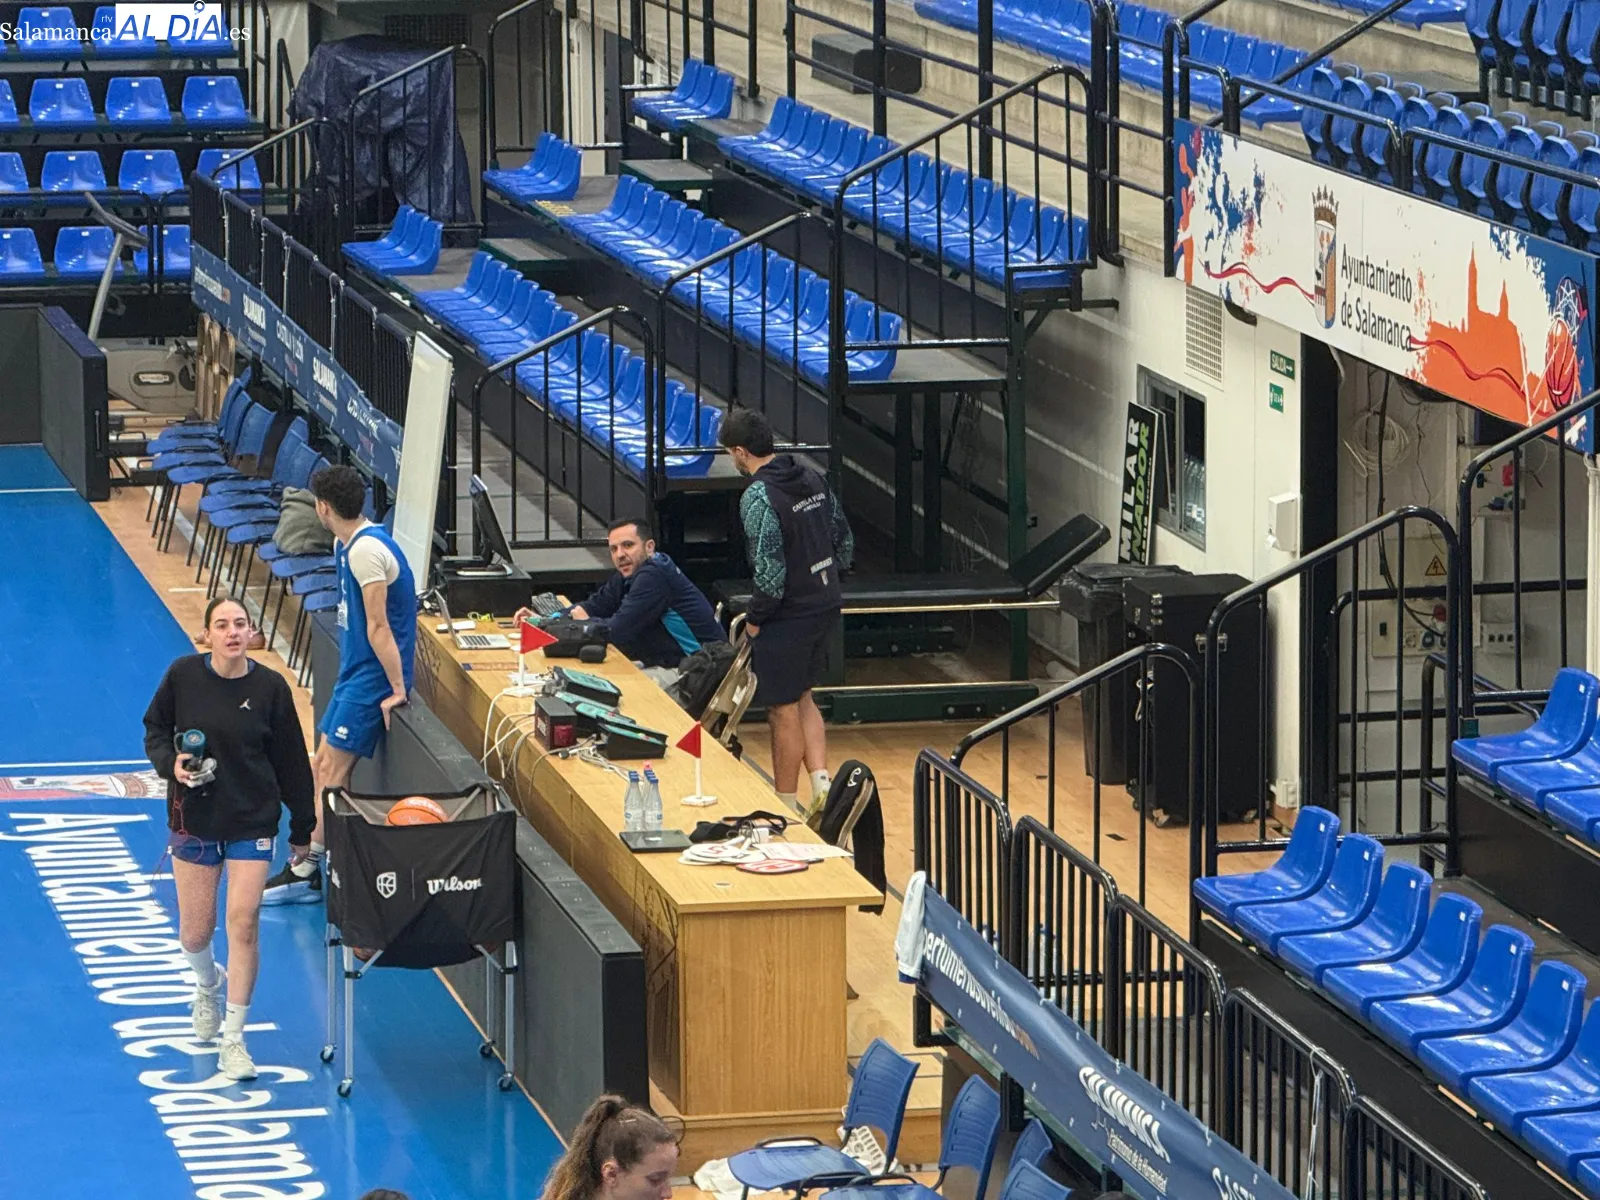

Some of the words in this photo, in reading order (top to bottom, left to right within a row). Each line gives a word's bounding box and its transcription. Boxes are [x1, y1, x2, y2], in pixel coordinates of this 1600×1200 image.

[1341, 243, 1413, 304] Ayuntamiento
[1341, 291, 1353, 330] de
[1355, 296, 1412, 353] Salamanca
[1119, 417, 1140, 562] MILAR
[0, 812, 203, 1006] Ayuntamiento
[427, 876, 483, 895] Wilson
